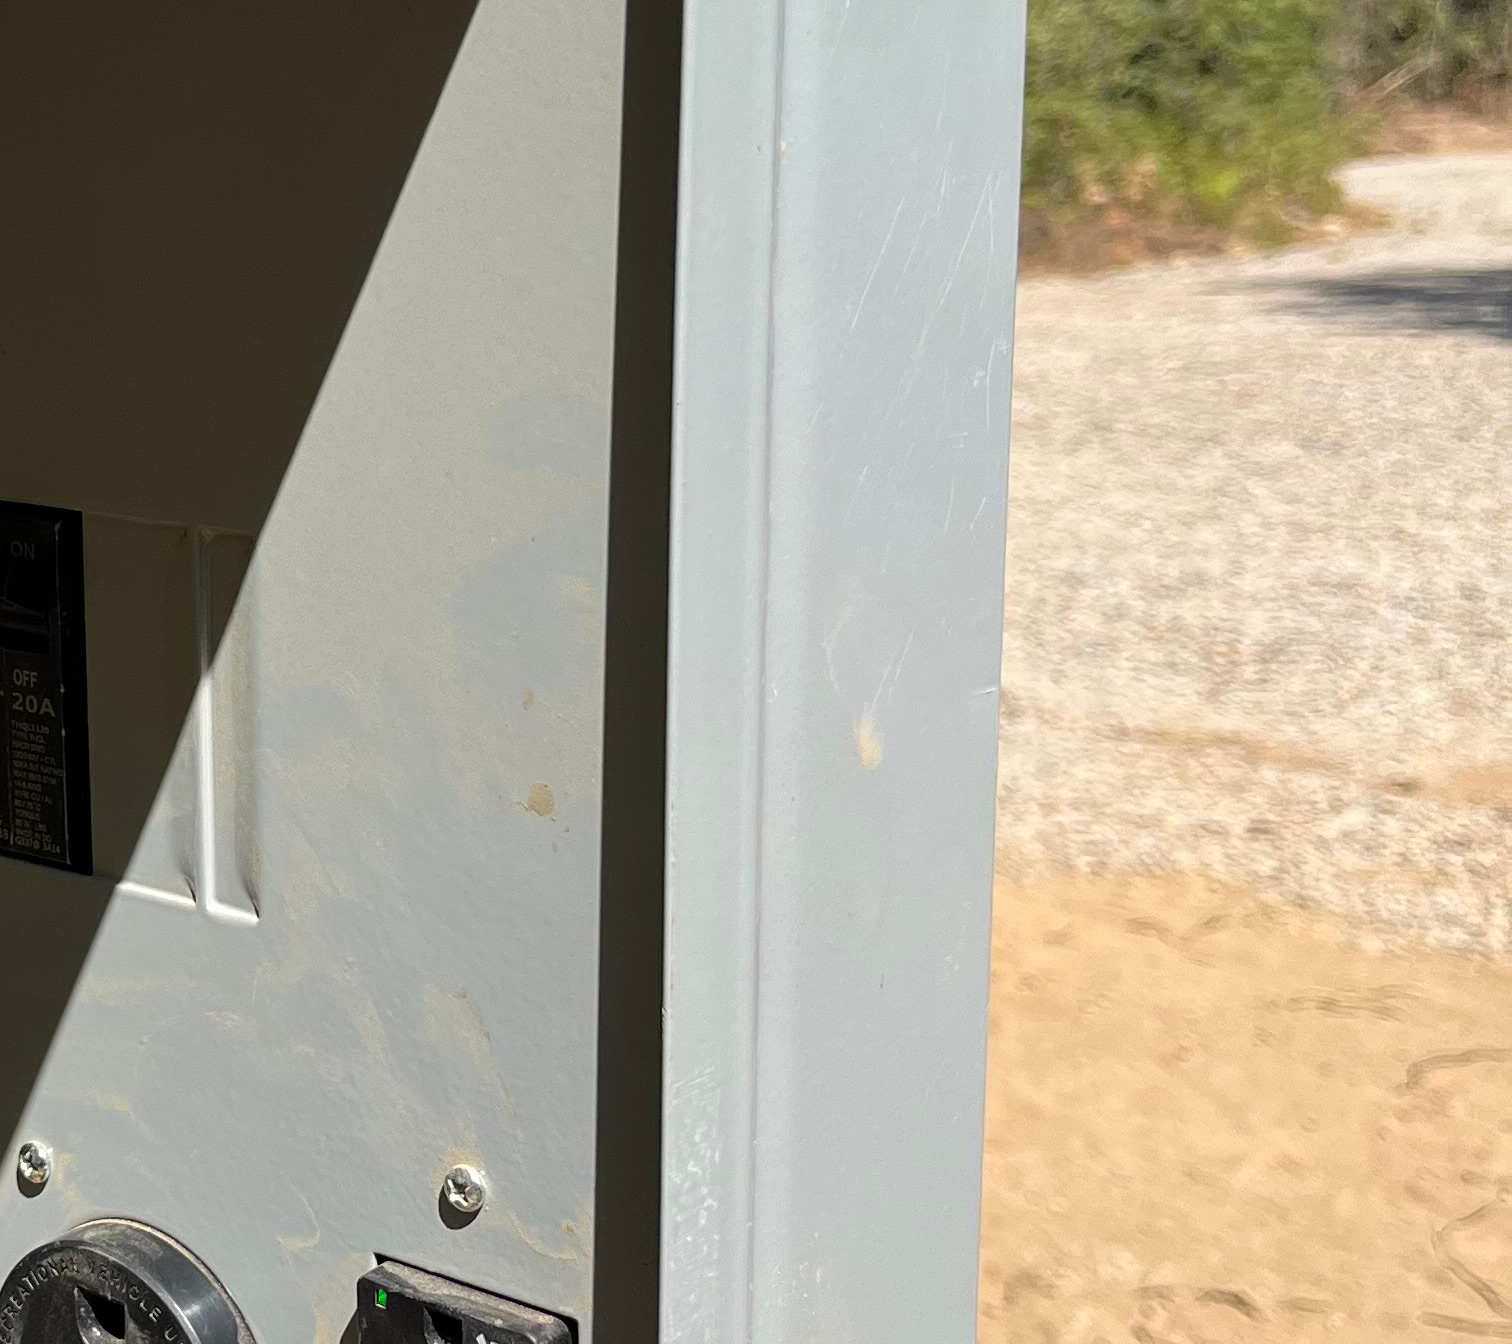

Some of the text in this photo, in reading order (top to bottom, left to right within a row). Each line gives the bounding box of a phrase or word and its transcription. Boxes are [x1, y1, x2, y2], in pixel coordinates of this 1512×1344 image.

[10, 540, 36, 560] ON
[12, 668, 38, 688] OFF
[11, 692, 56, 718] 20A
